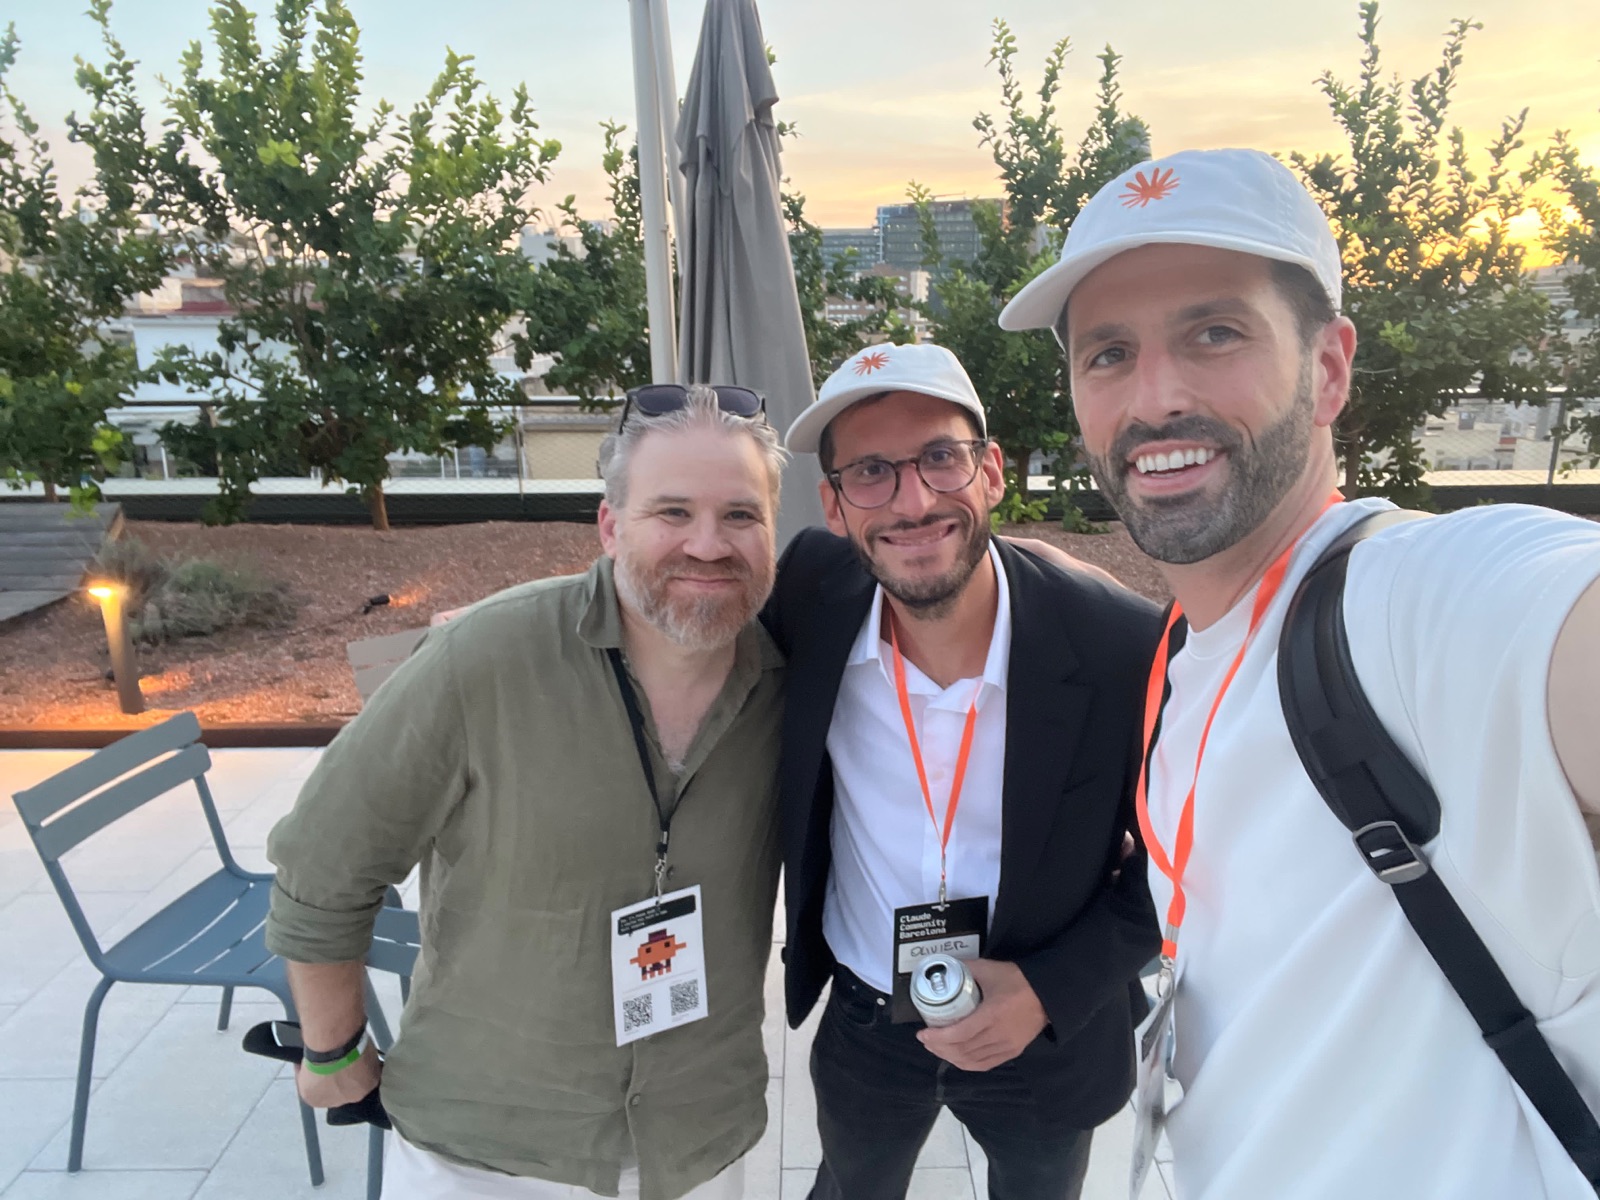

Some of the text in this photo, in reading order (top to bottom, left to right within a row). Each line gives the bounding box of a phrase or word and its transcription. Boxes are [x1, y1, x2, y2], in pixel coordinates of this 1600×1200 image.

[900, 913, 932, 923] Claude
[899, 919, 946, 931] Community
[899, 927, 946, 939] Barcelona
[910, 940, 969, 957] OLIVIER
